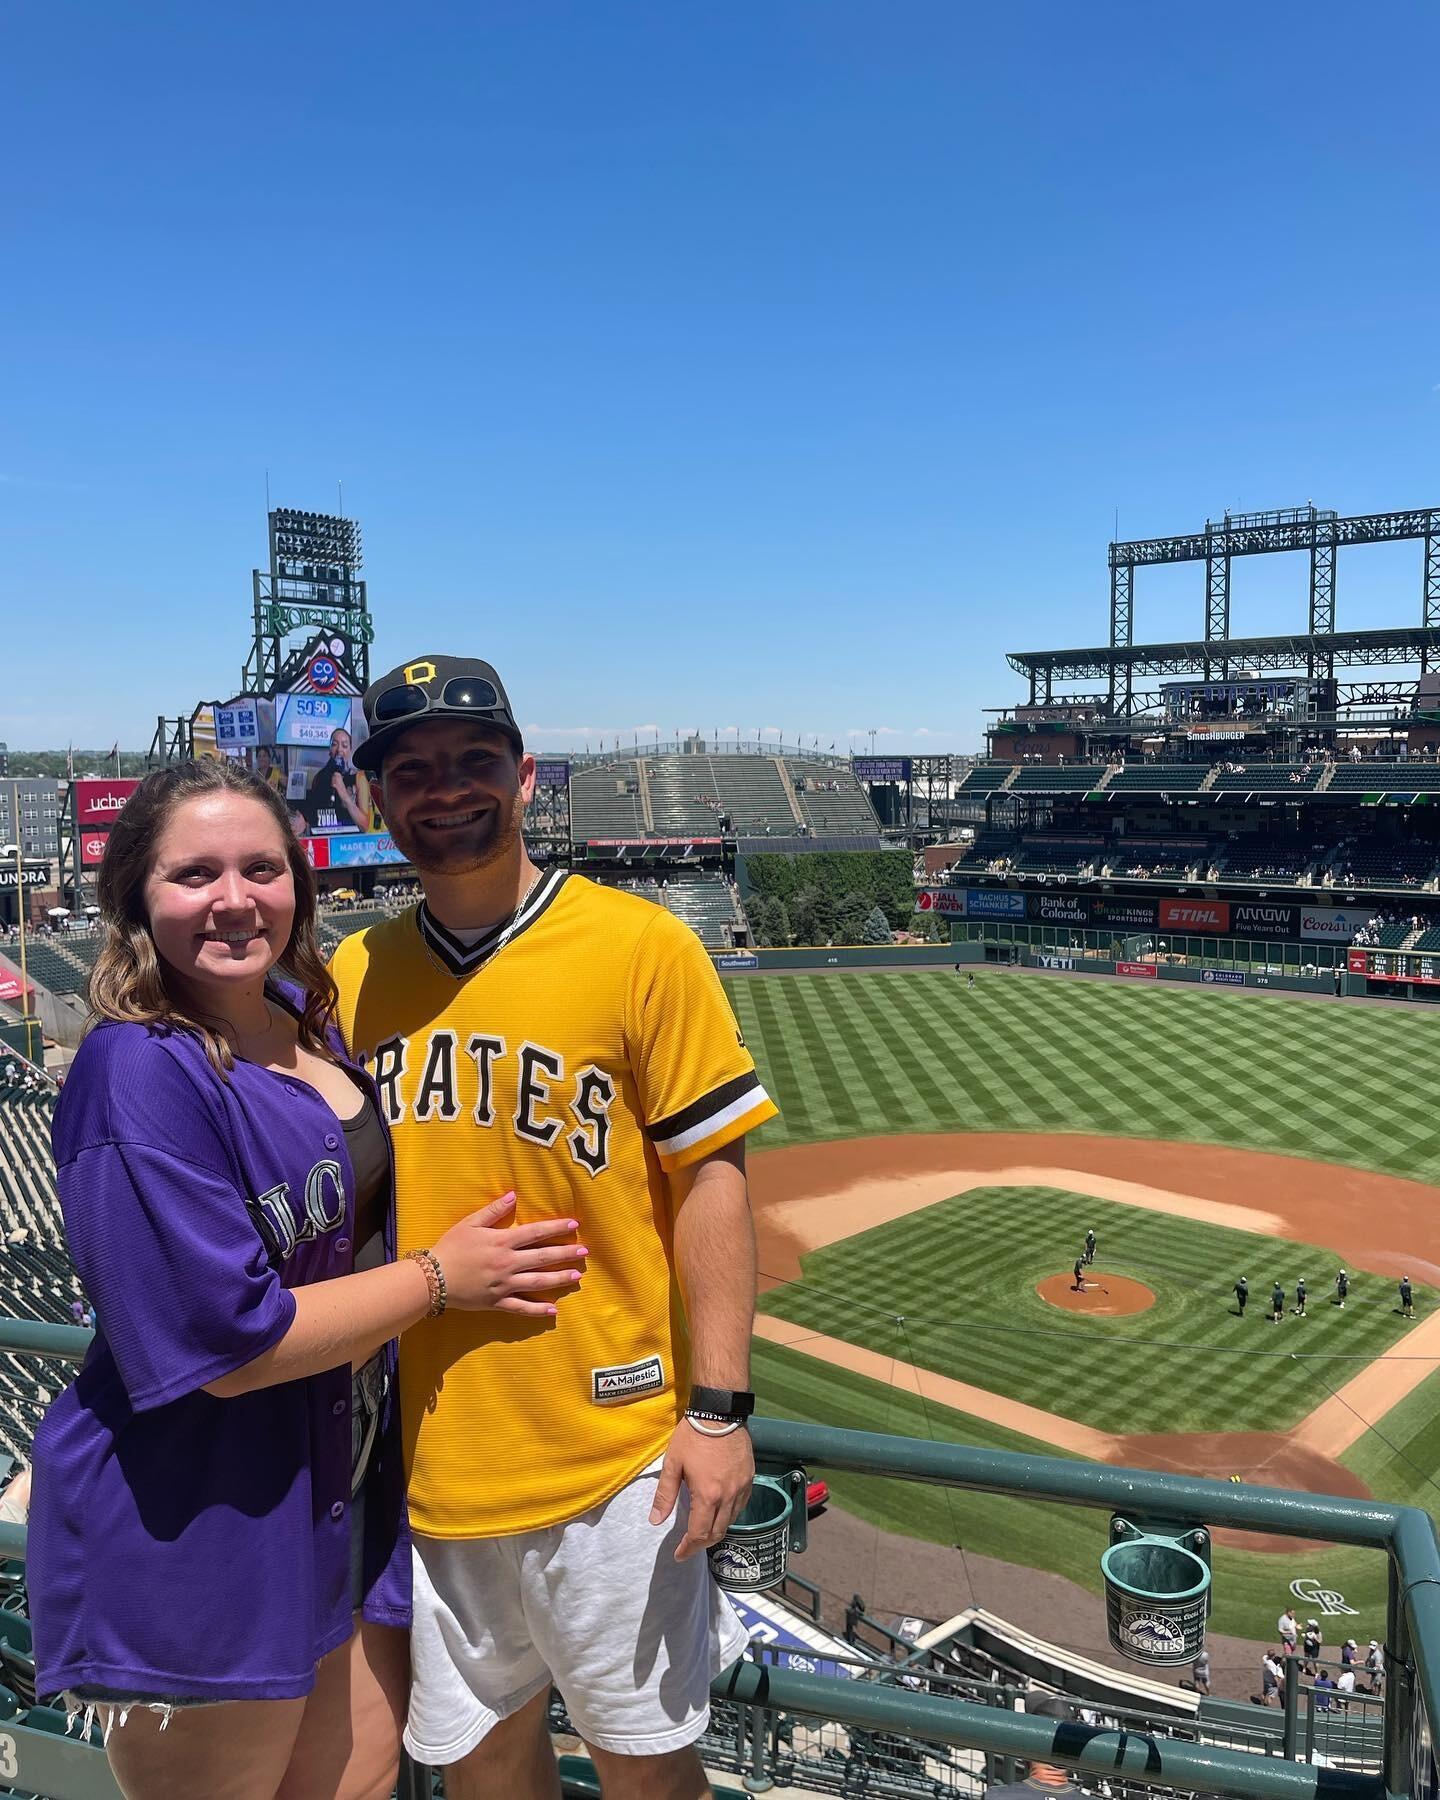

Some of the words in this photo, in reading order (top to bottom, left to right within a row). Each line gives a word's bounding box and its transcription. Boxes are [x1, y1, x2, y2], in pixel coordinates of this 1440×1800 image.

[262, 604, 375, 644] ROCKIES
[314, 662, 333, 673] CO
[403, 661, 437, 685] P
[340, 842, 362, 852] MADE
[364, 841, 375, 850] TO
[969, 900, 1009, 910] SCHANKER
[1040, 896, 1065, 908] Bank
[1067, 897, 1079, 909] of
[1040, 907, 1087, 920] Colorado
[1107, 915, 1153, 923] SPORTSBOOK
[1168, 908, 1220, 923] STIHL
[1236, 907, 1291, 922] ARROW
[1236, 923, 1251, 931] Five
[1253, 924, 1273, 932] Years
[1274, 925, 1290, 933] Out
[1303, 917, 1341, 932] Coors
[1040, 955, 1072, 970] YETI
[356, 1029, 616, 1178] RATES
[617, 1369, 657, 1386] Majestic
[1122, 1613, 1179, 1637] COLORADO
[1120, 1630, 1183, 1652] ROCKIES
[0, 1733, 18, 1778] 3
